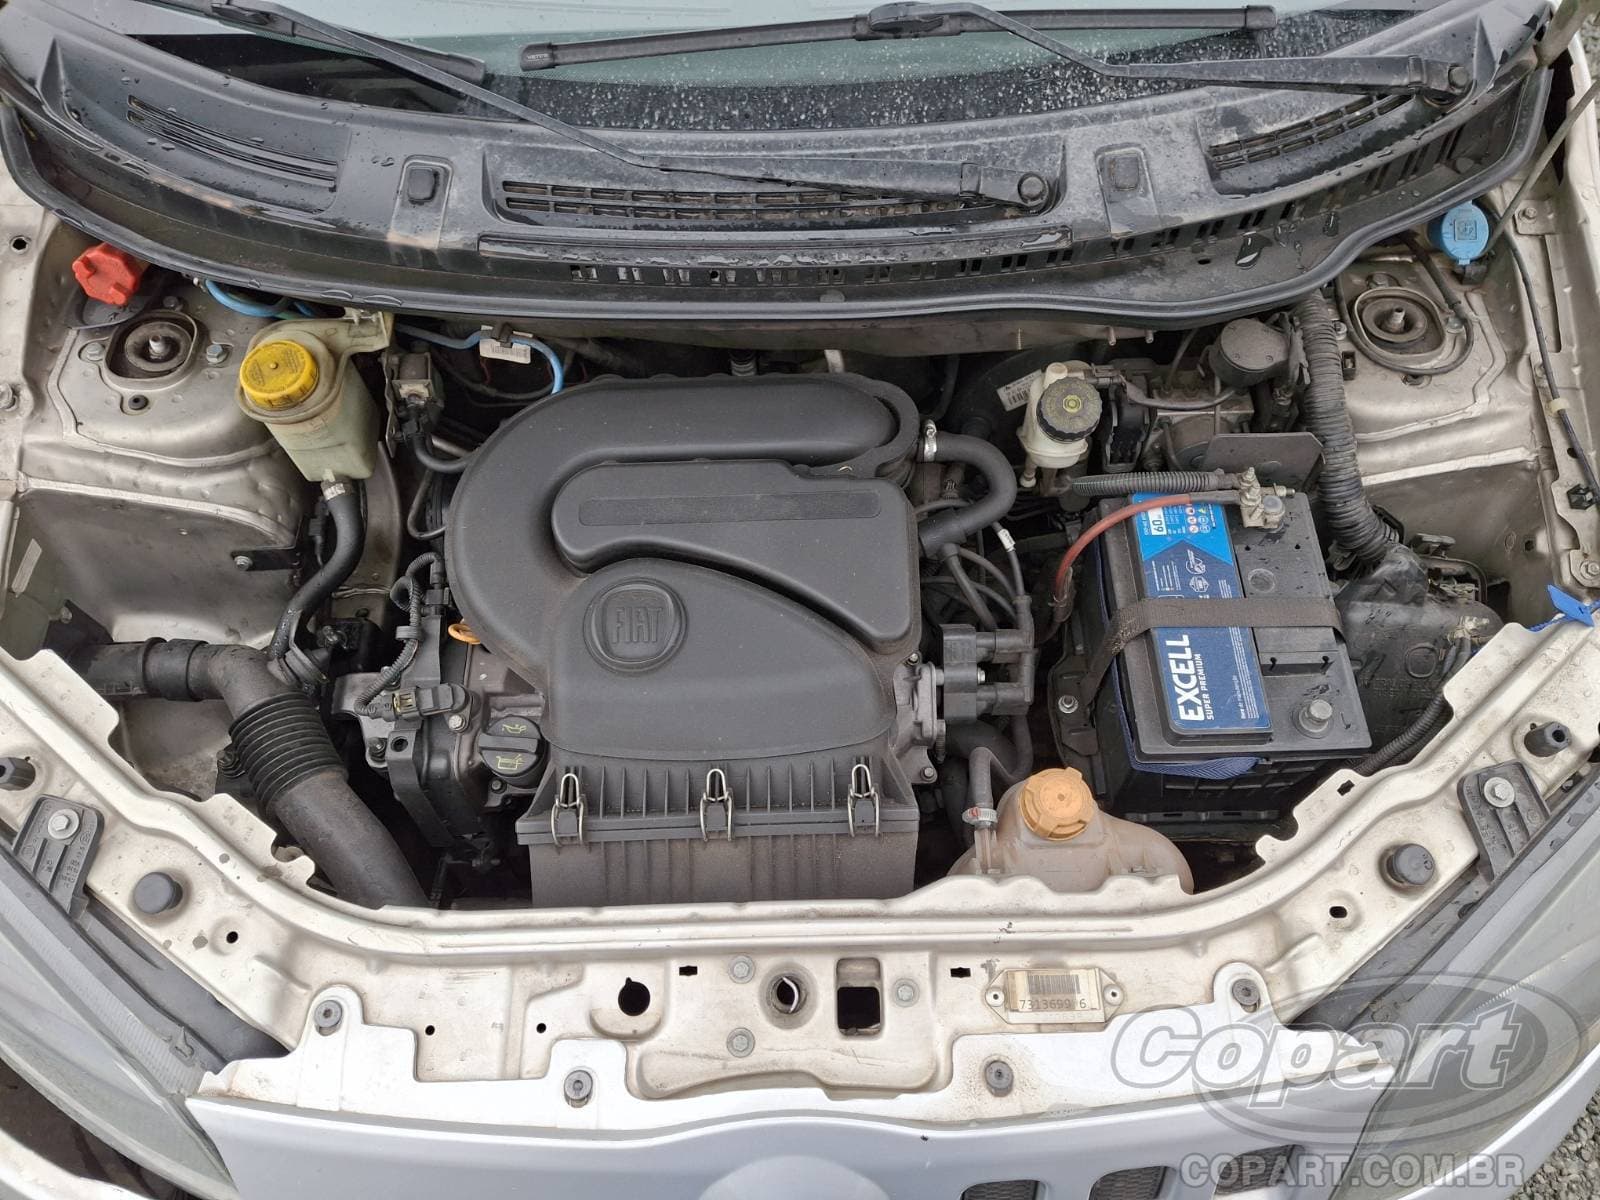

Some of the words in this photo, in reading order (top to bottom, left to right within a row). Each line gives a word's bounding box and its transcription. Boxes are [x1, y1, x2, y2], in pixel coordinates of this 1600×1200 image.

[1152, 519, 1164, 533] 60
[612, 606, 663, 644] FIAT
[1165, 634, 1205, 721] EXCELL
[1194, 653, 1209, 691] PREMIUM
[1202, 693, 1215, 721] SUPER
